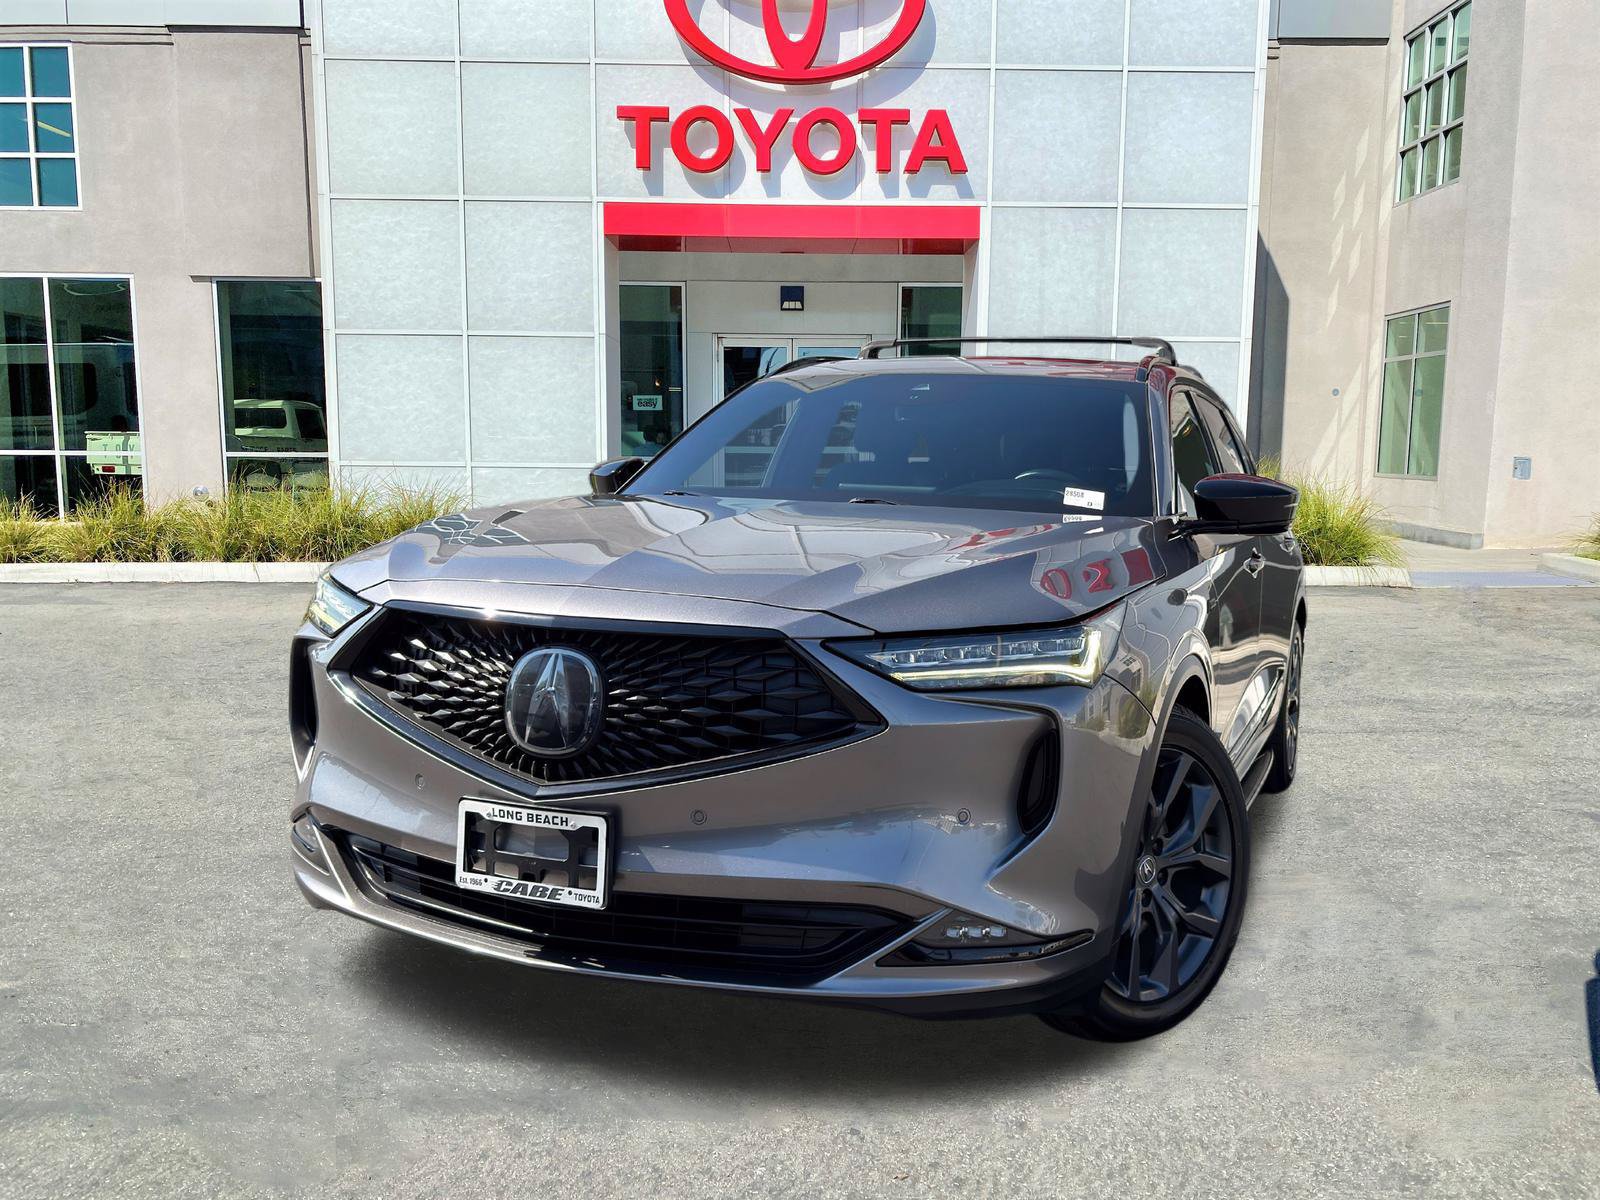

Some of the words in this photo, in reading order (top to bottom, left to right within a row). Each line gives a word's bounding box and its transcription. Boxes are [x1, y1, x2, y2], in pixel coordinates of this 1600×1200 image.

[616, 104, 968, 175] TOYOTA
[637, 400, 658, 409] easy
[491, 807, 523, 821] LONG
[526, 813, 569, 827] BEACH
[491, 879, 566, 901] CABE
[573, 892, 600, 904] TOYOTA
